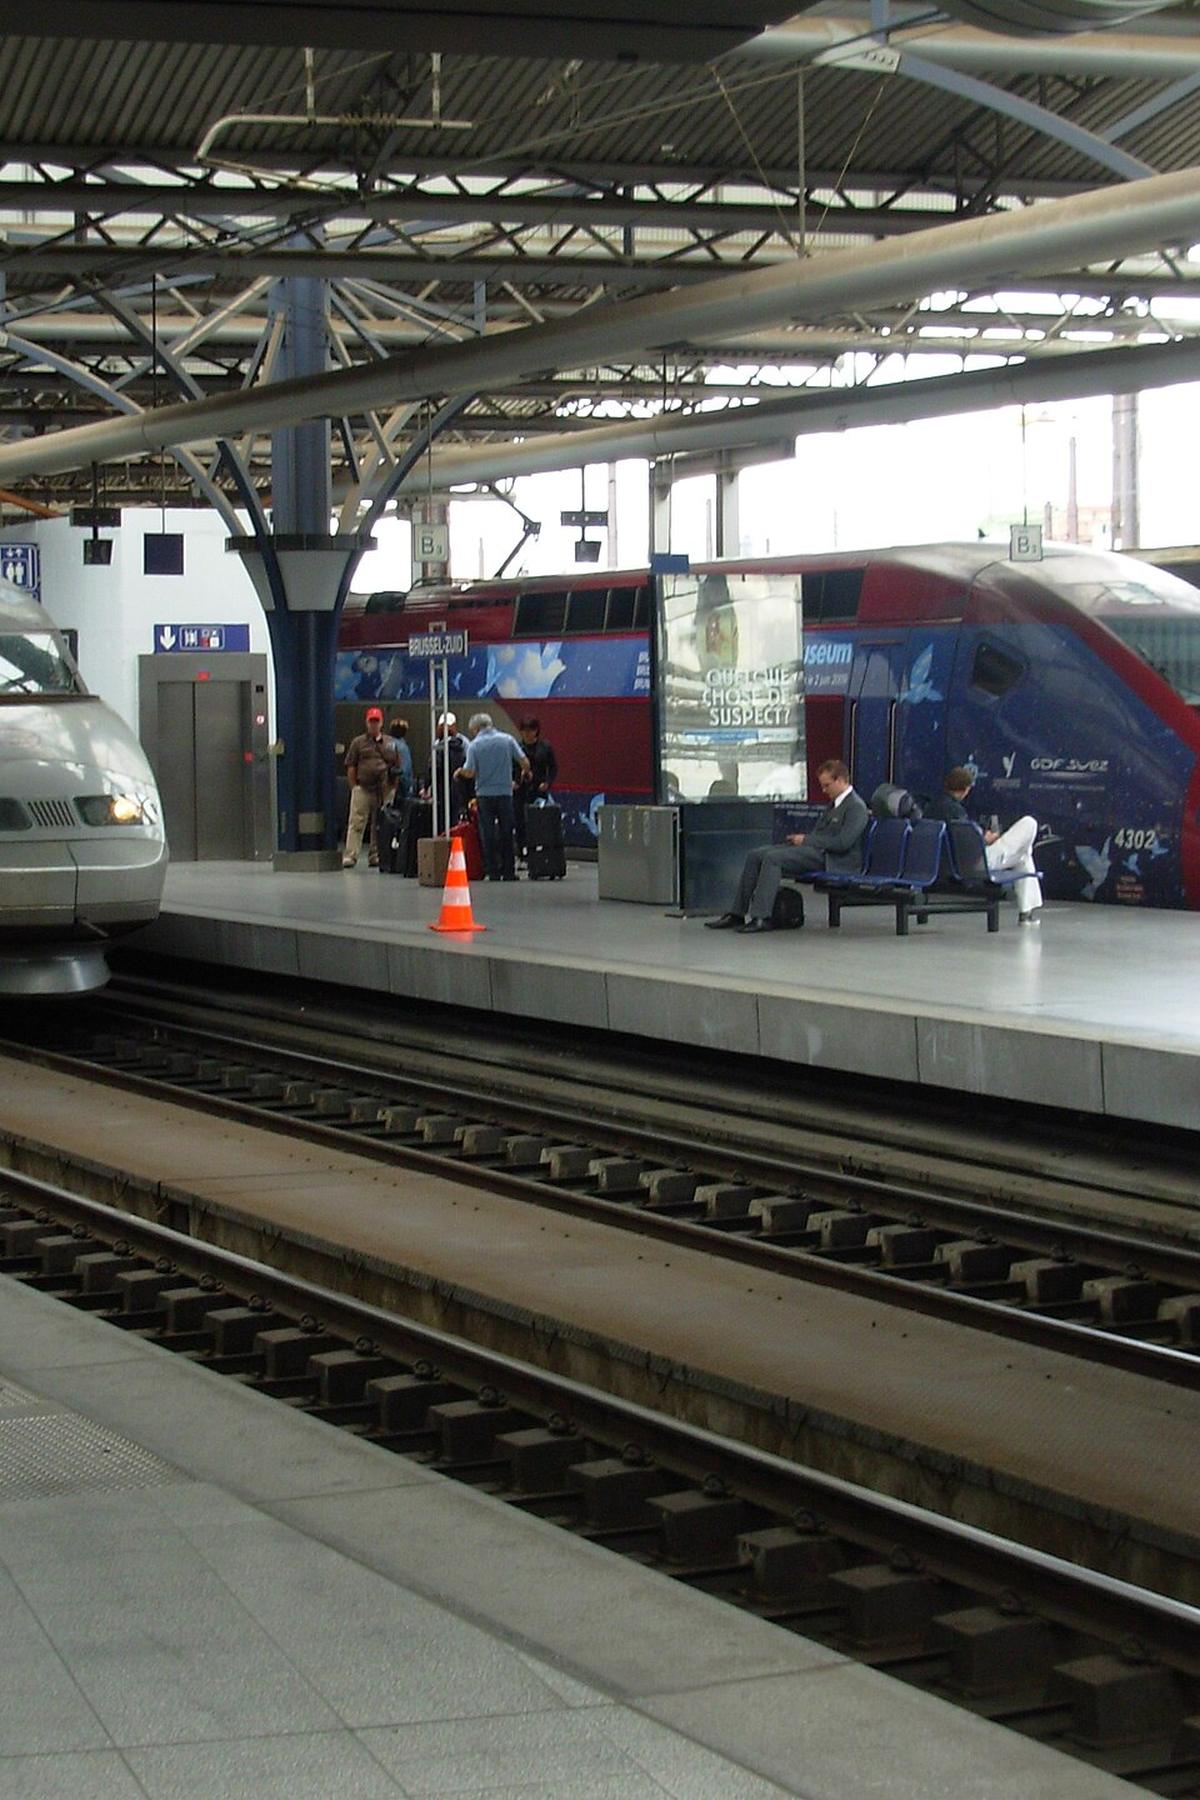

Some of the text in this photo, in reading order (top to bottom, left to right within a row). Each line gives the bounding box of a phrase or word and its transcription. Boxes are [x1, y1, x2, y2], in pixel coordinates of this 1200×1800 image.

[702, 688, 762, 706] CHOSE
[709, 706, 791, 726] SUSPECT?
[1114, 828, 1156, 850] 4302
